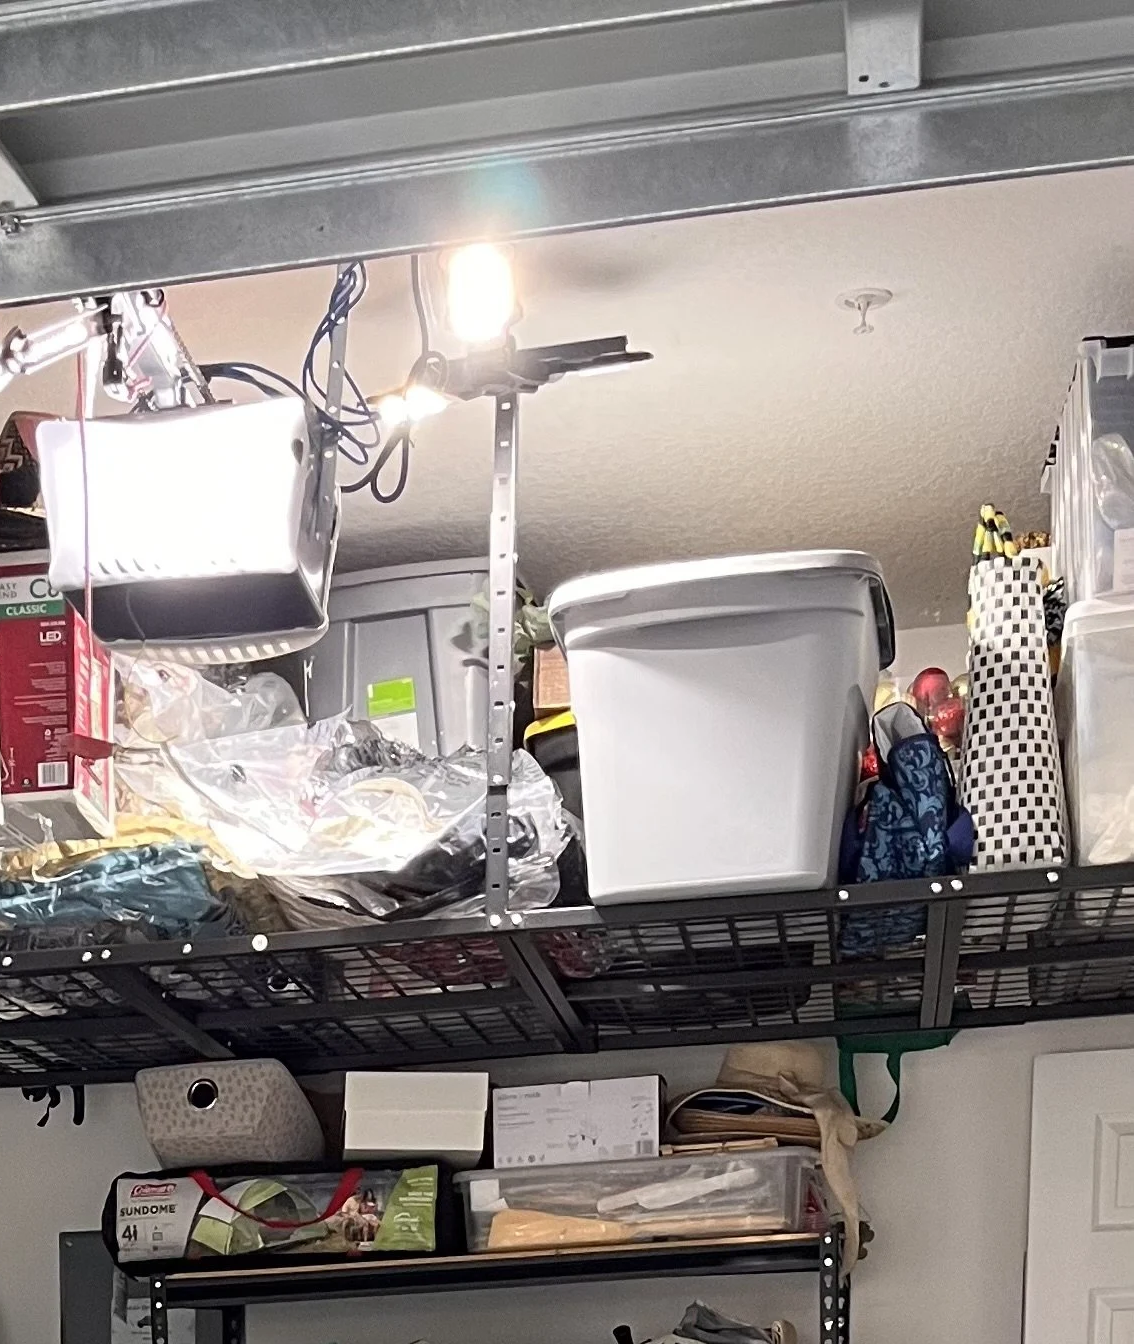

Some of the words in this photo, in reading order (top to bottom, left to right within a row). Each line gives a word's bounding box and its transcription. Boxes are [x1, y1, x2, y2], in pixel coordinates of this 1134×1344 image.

[5, 603, 48, 617] CLASSIC
[39, 630, 62, 643] LED
[119, 1203, 176, 1217] SUNDOME
[122, 1224, 132, 1241] 4
